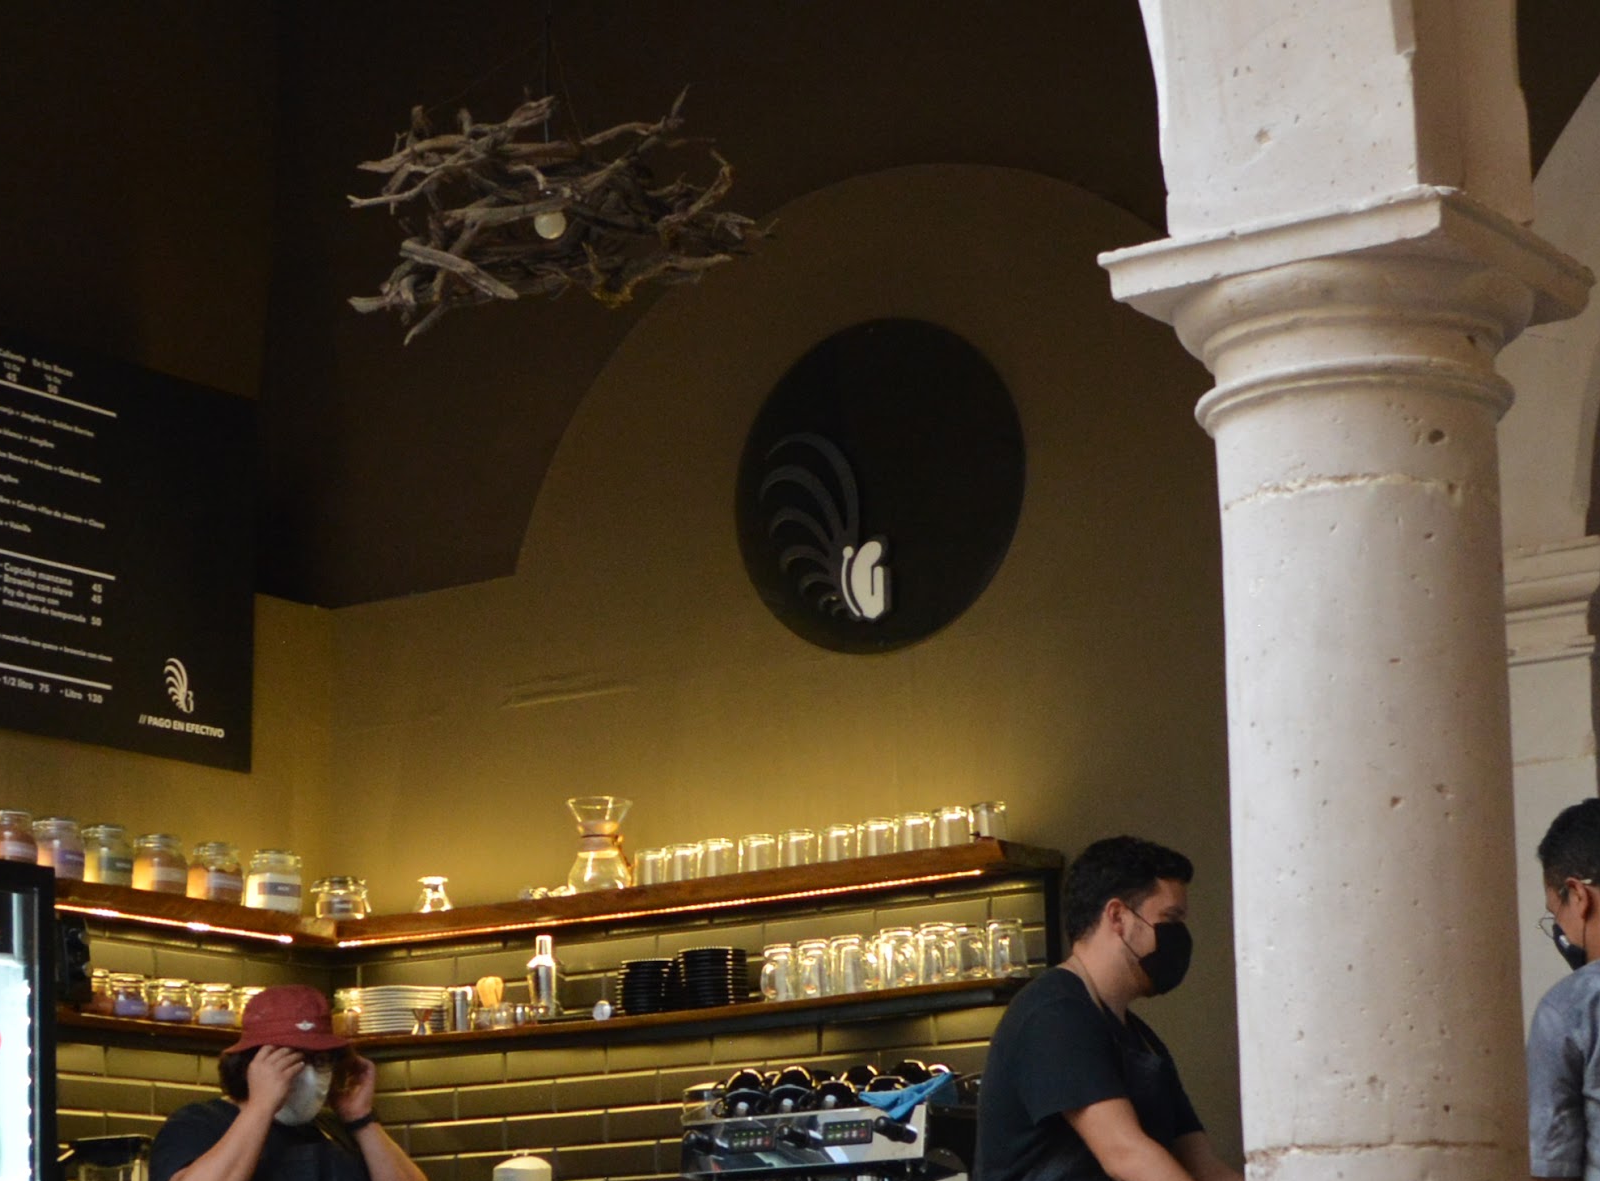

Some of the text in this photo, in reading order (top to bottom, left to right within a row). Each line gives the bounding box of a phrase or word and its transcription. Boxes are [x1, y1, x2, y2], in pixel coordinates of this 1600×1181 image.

[147, 715, 171, 729] PAGO
[173, 720, 184, 731] EN
[186, 722, 225, 738] EFECTIVO
